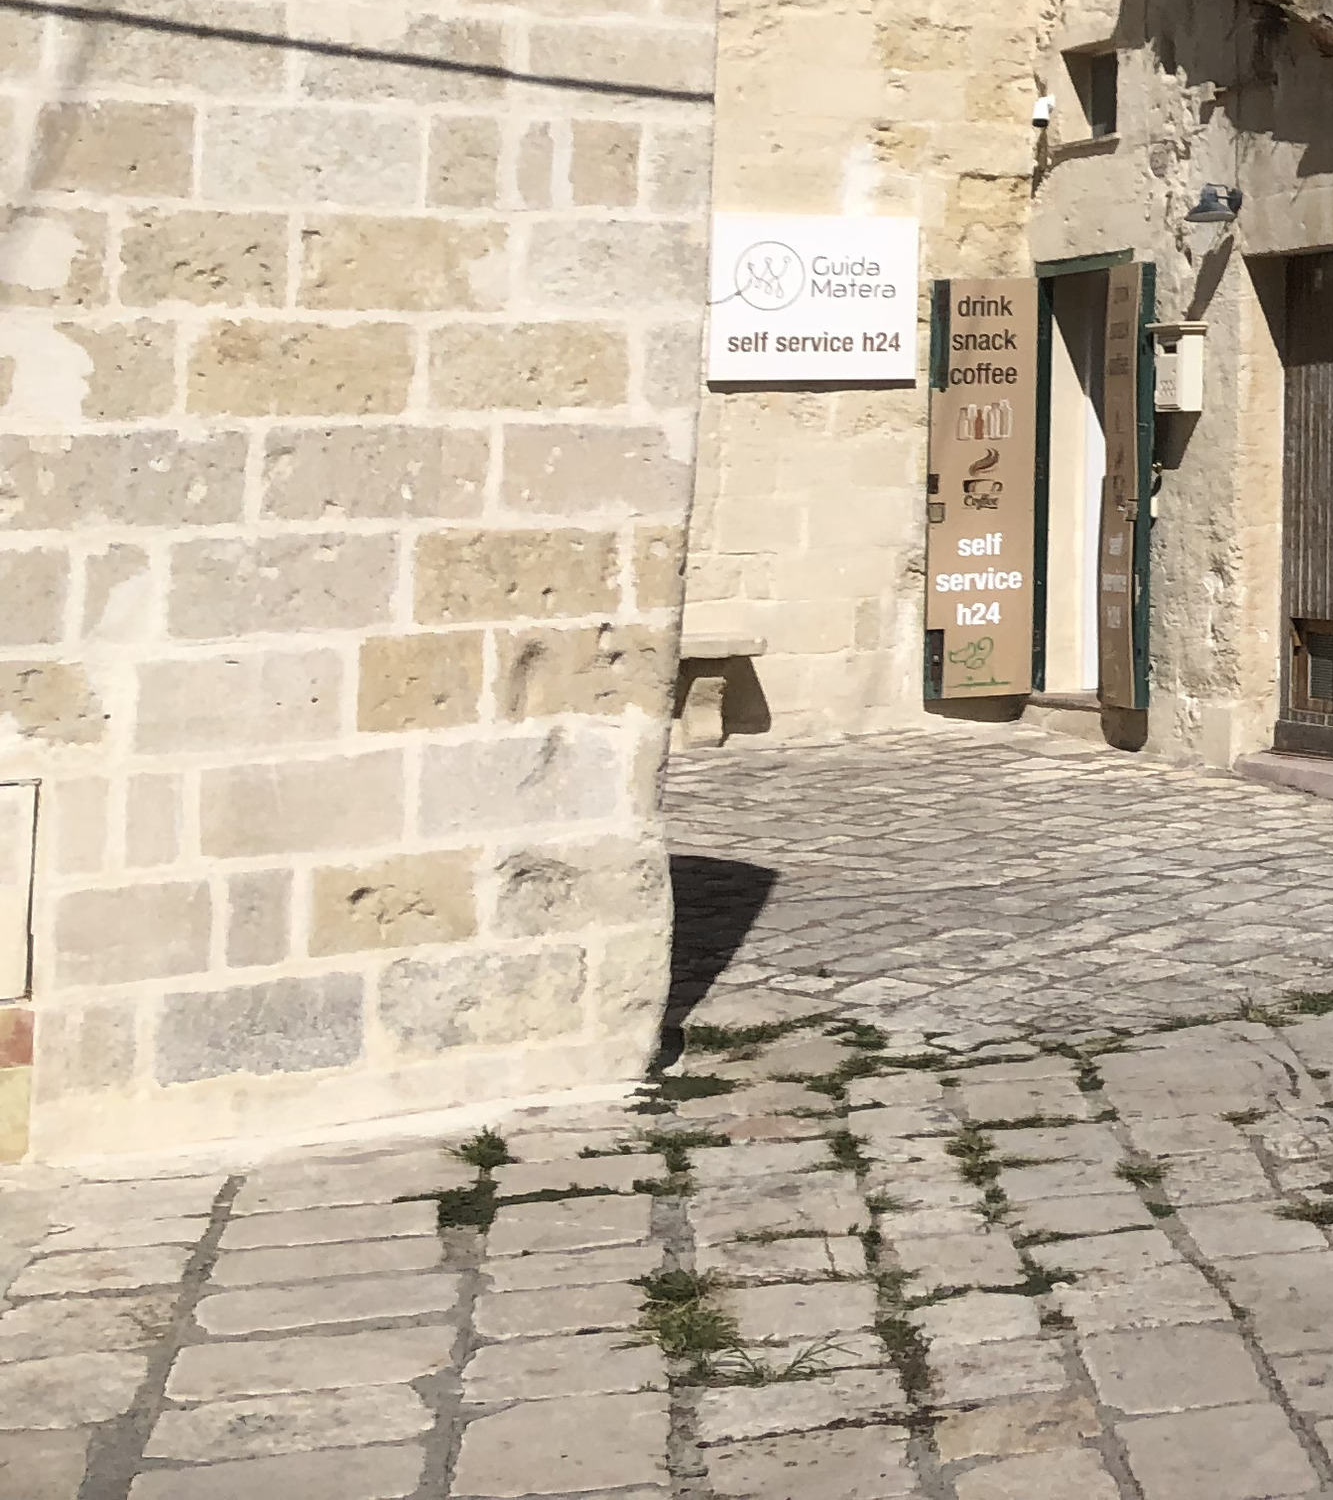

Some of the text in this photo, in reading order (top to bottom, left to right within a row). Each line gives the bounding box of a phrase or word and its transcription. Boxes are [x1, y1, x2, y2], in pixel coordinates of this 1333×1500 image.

[811, 255, 881, 277] Guida
[810, 278, 897, 299] Matera
[957, 295, 1014, 317] drink
[727, 331, 901, 353] self service h24
[952, 328, 1018, 351] snack
[949, 362, 1018, 385] coffee
[957, 532, 1003, 557] self
[935, 567, 1023, 592] service
[956, 601, 1002, 626] h24
